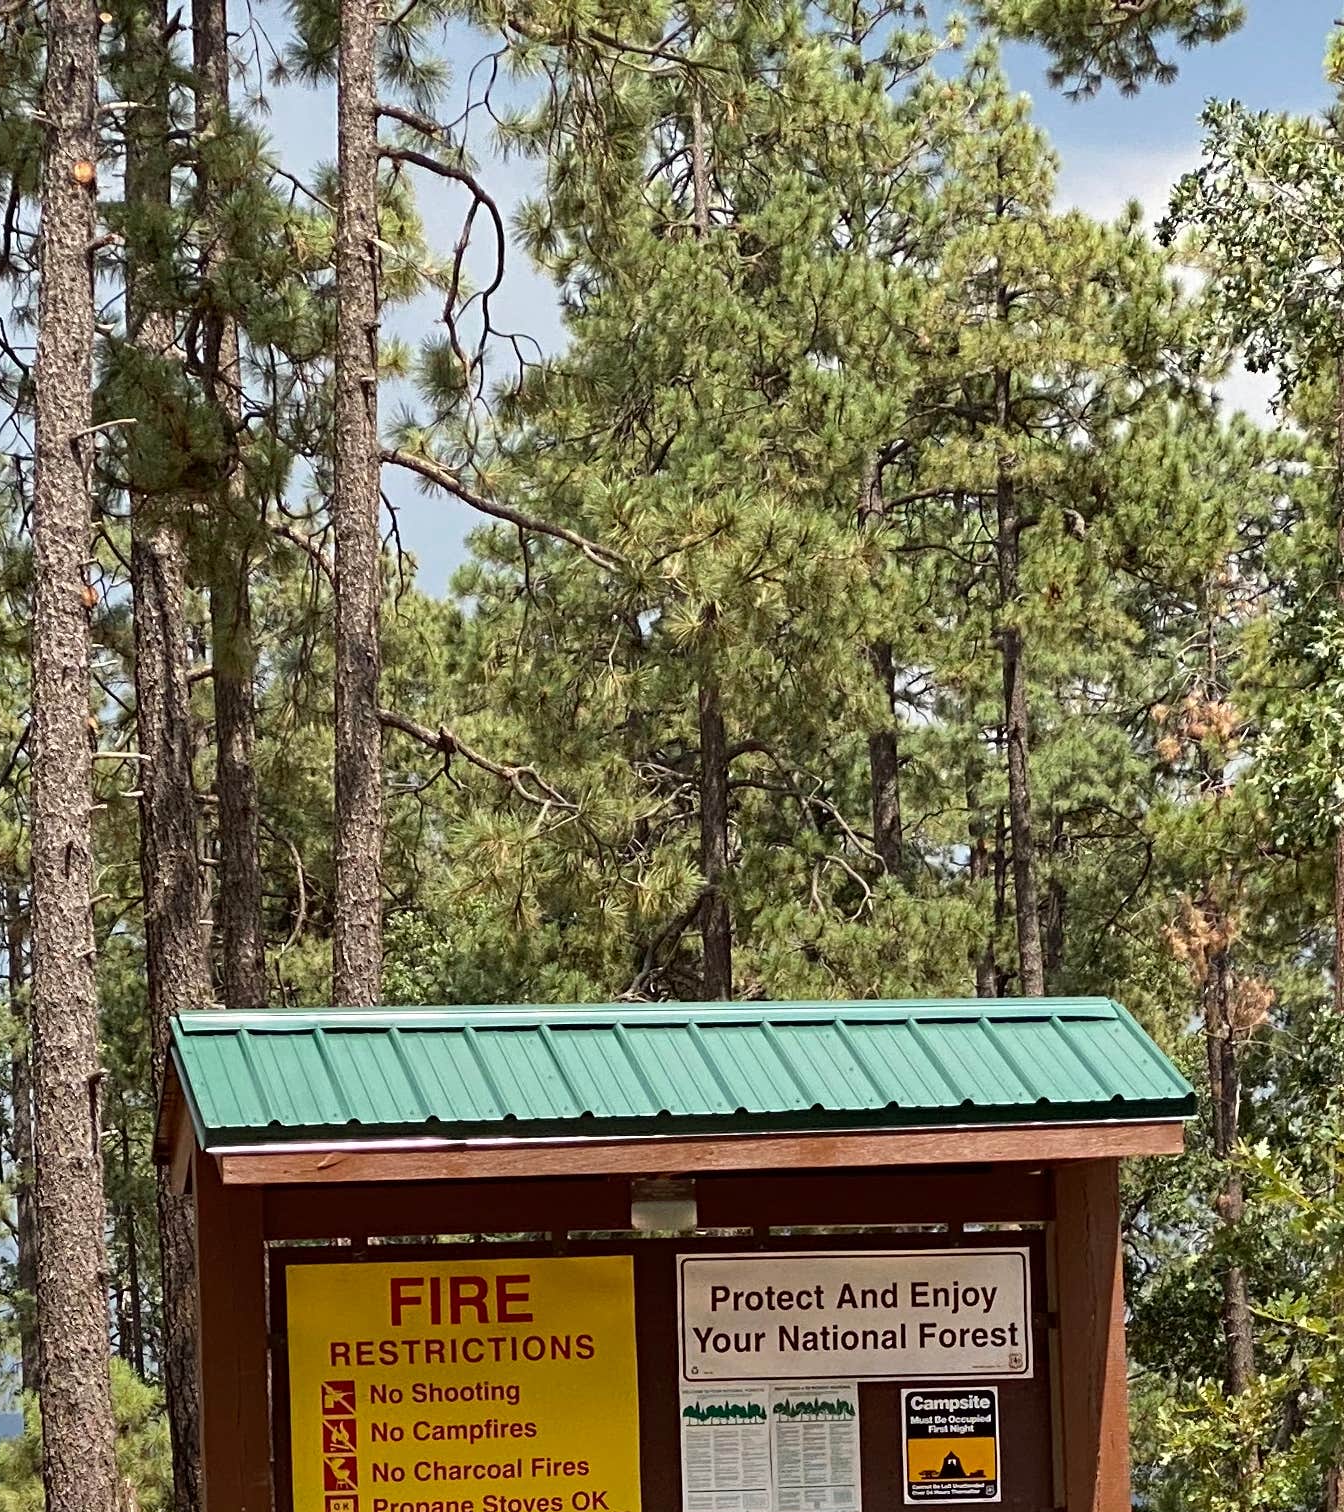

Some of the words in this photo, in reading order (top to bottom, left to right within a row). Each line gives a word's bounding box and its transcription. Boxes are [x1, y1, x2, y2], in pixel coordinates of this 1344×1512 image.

[390, 1275, 533, 1327] FIRE
[710, 1284, 824, 1311] Protect
[836, 1282, 898, 1309] And
[911, 1281, 998, 1314] Enjoy
[693, 1326, 766, 1353] Your
[778, 1323, 906, 1352] National
[919, 1322, 1019, 1349] Forest
[330, 1334, 595, 1367] RESTRICTIONS
[370, 1384, 403, 1404] No
[412, 1381, 520, 1405] Shooting
[911, 1395, 990, 1412] Campsite
[910, 1416, 932, 1424] Must
[948, 1414, 991, 1424] Occupied
[928, 1425, 948, 1433] First
[950, 1425, 974, 1434] Night
[371, 1422, 404, 1442] No
[413, 1420, 537, 1445] Campfires
[372, 1462, 405, 1482] No
[414, 1458, 522, 1480] Charcoal
[531, 1457, 590, 1477] Fires
[571, 1491, 610, 1511] OK
